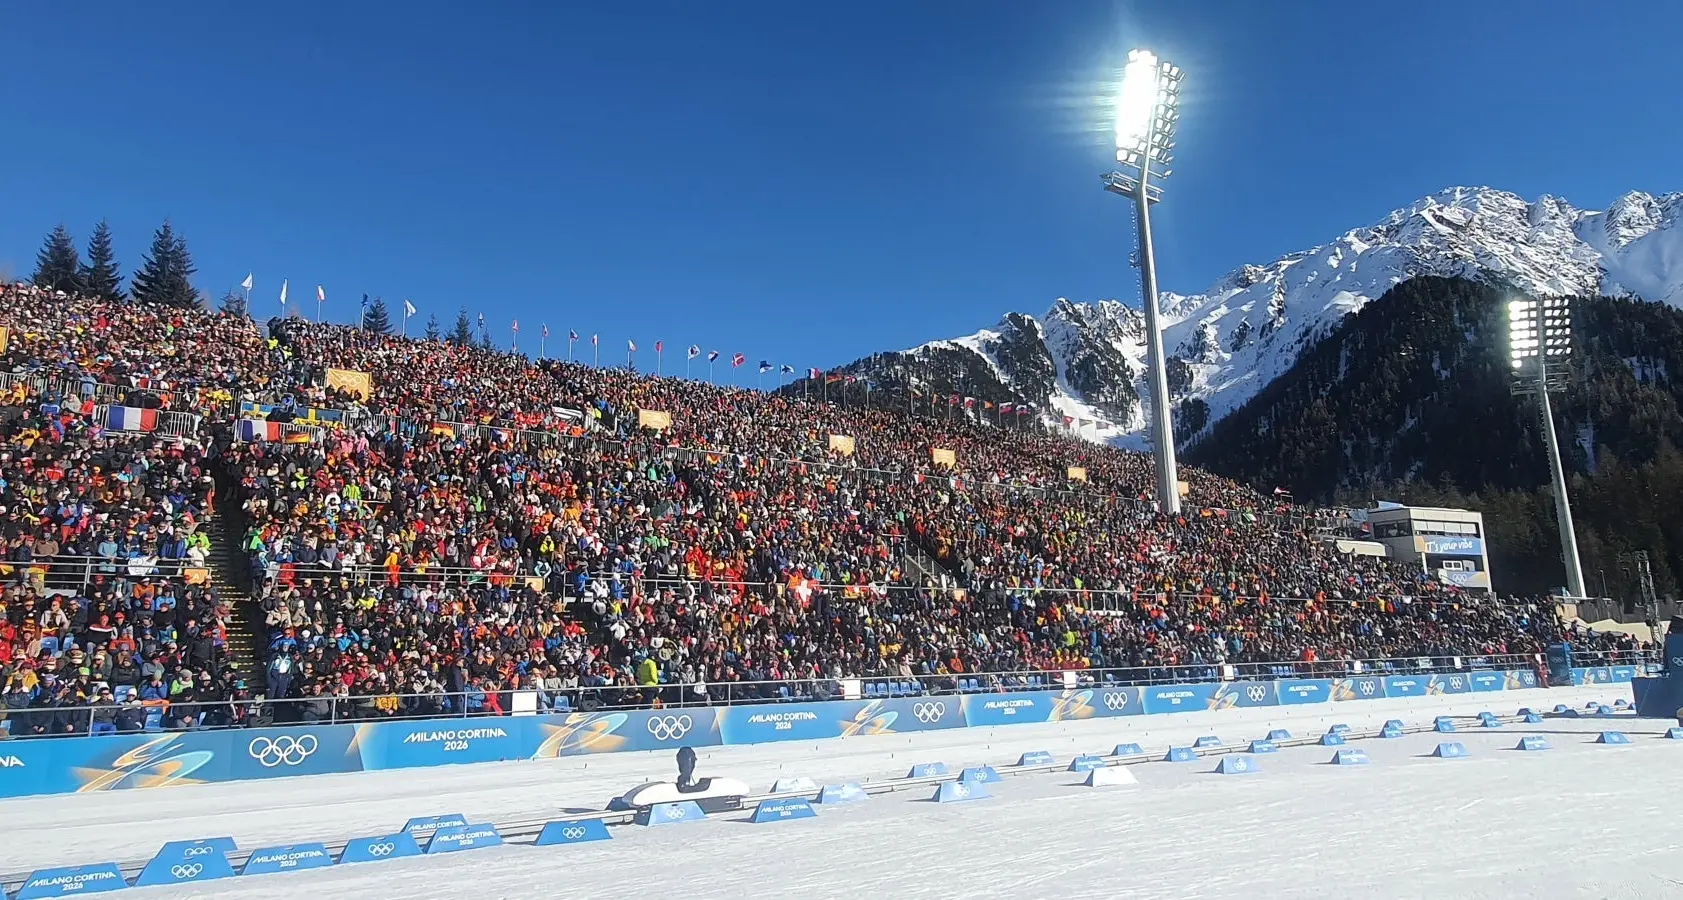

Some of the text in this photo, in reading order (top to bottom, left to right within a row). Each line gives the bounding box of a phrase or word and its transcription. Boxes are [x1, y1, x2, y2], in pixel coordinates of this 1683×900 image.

[748, 711, 817, 723] MILANO CORTINA
[775, 721, 792, 730] 2026
[403, 727, 508, 743] MILANO CORTINA
[443, 740, 468, 751] 2026
[408, 820, 465, 831] MILANO CORTINA
[436, 830, 495, 843] MILANO CORTINA
[252, 850, 324, 864] MILANO CORTINA
[280, 860, 297, 868] 2026
[28, 871, 117, 888] MILANO CORTINA
[62, 881, 84, 891] 2026
